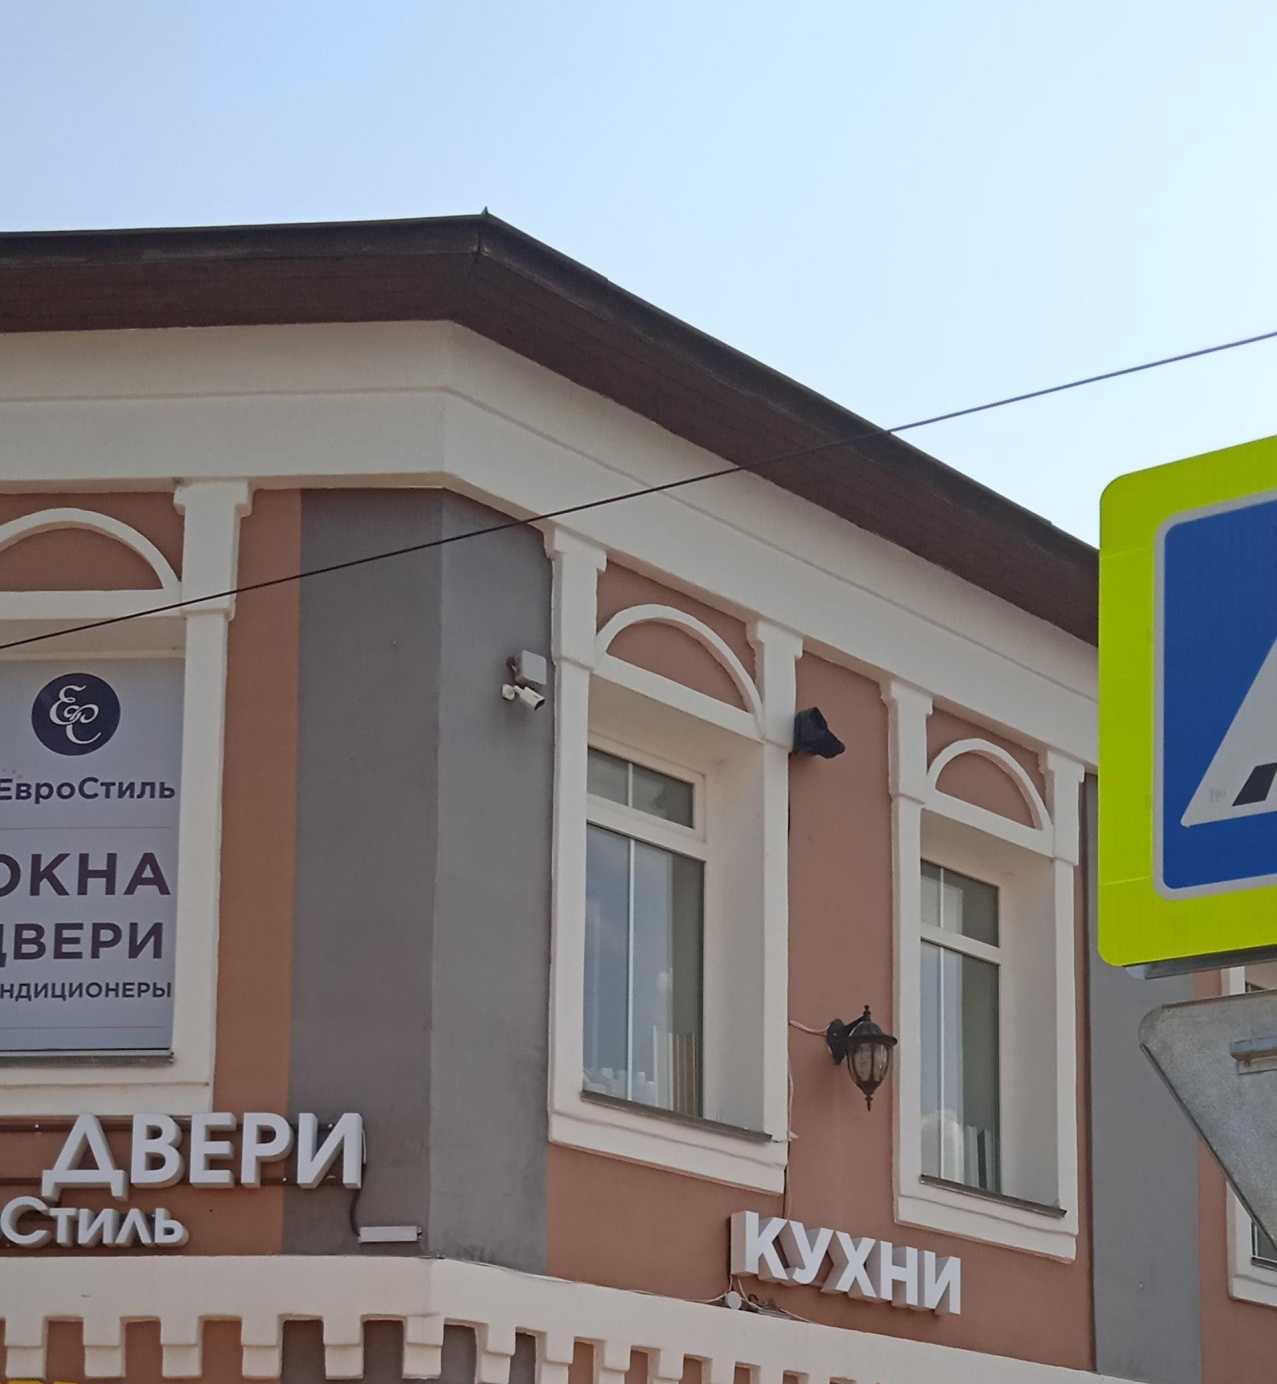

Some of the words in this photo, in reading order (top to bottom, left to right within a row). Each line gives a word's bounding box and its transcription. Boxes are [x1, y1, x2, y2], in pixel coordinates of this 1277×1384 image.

[0, 776, 176, 805] ЕвроСтиль
[0, 922, 164, 968] ВЕРИ
[41, 1112, 364, 1199] ДВЕРИ
[0, 1196, 189, 1247] Стиль
[730, 1210, 961, 1315] КУХНИ
